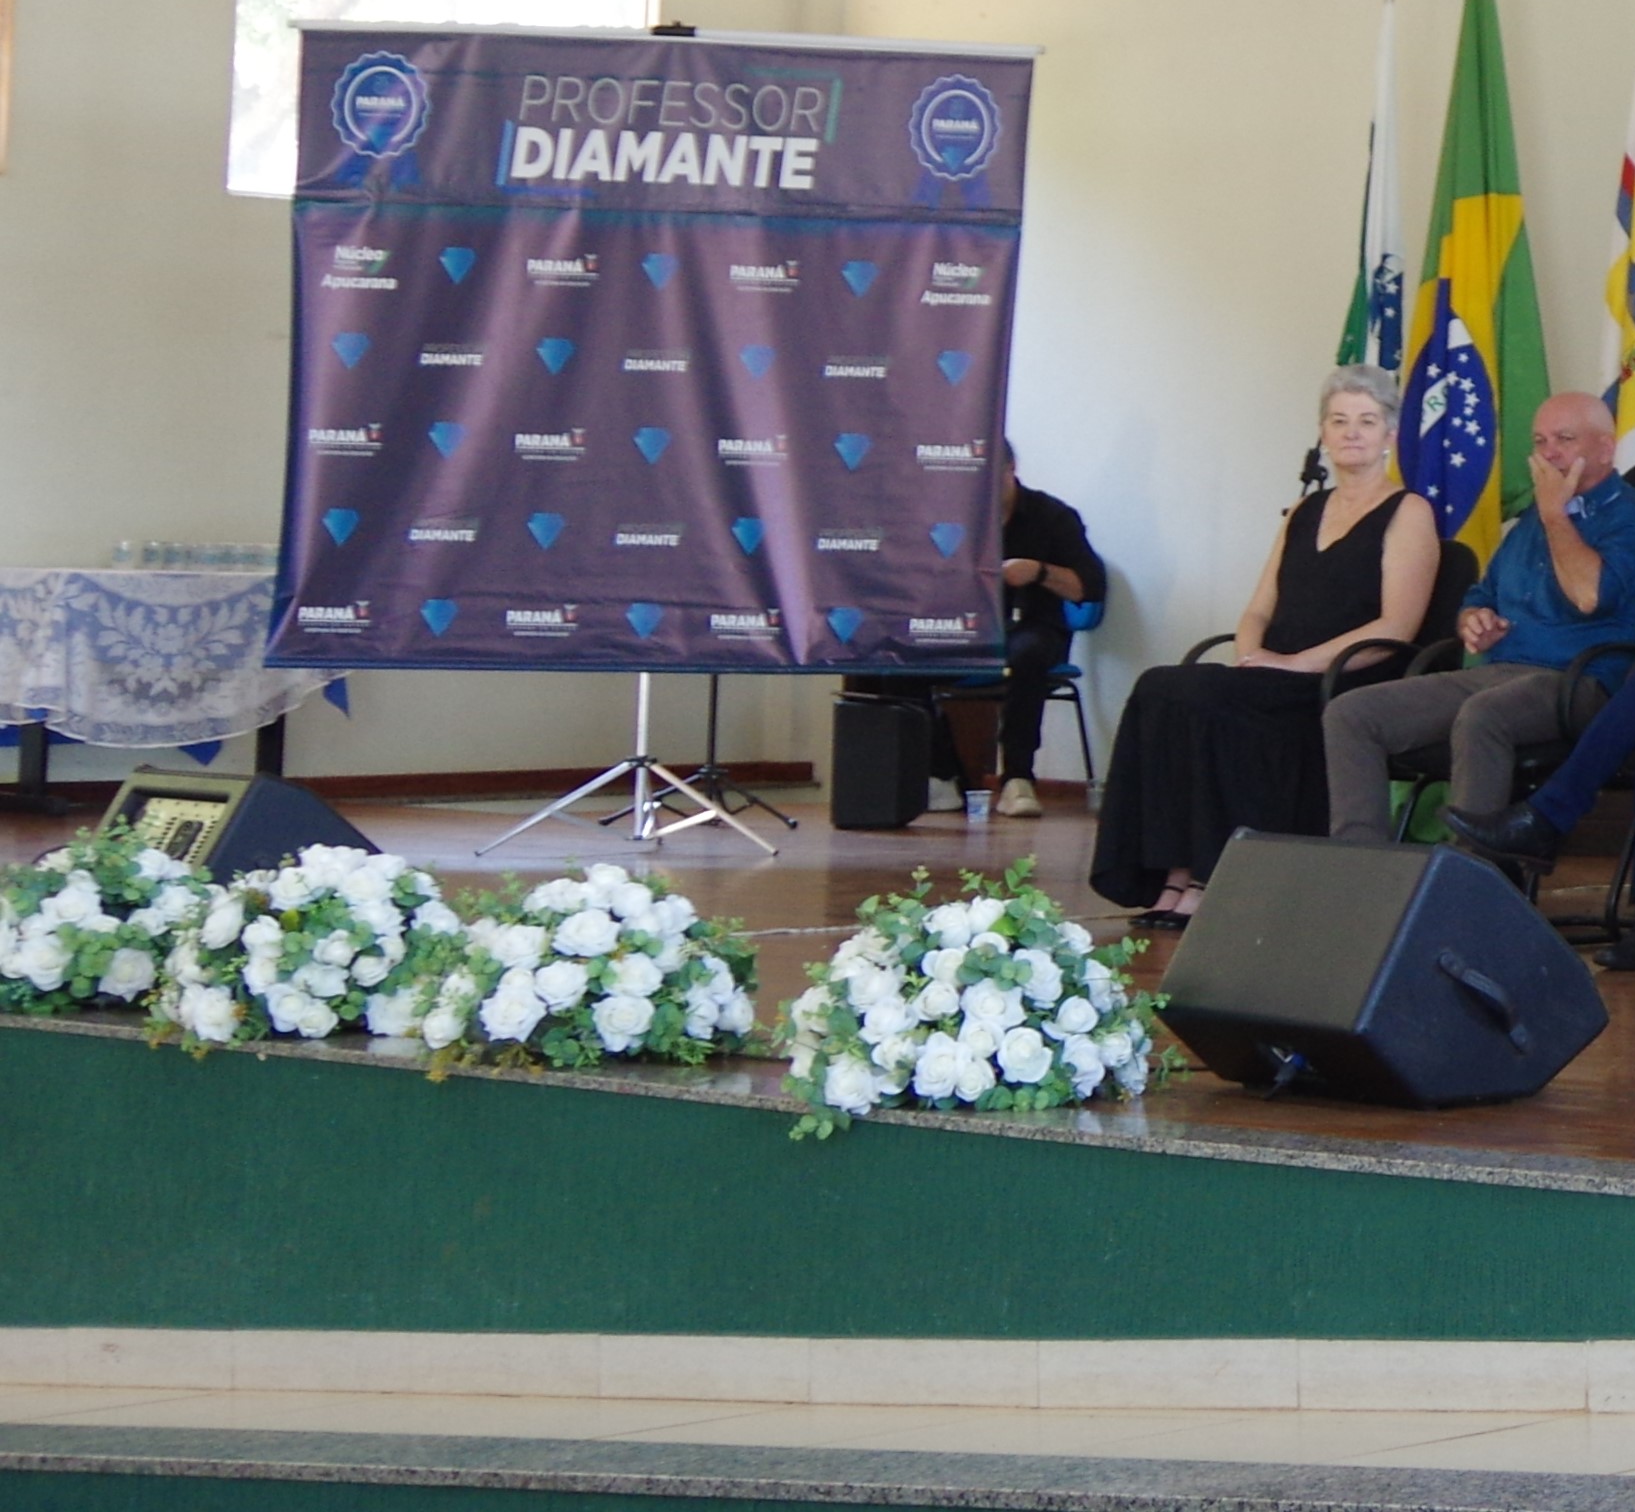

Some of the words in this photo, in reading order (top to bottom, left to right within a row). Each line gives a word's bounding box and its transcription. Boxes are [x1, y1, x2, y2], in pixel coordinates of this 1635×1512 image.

[520, 75, 826, 133] PROFESSOR
[510, 126, 820, 190] DIAMANTE
[729, 264, 784, 279] PARANÁ
[320, 273, 398, 290] Apucarana
[921, 289, 992, 306] Apucarana
[420, 353, 484, 366] DIAMANTE
[623, 358, 688, 372] DIAMANTE
[824, 364, 887, 378] DIAMANTE
[308, 428, 368, 443] PARANÁ
[515, 433, 571, 447] PARANÁ
[718, 438, 774, 453] PARANÁ
[916, 443, 972, 458] PARANÁ
[409, 528, 476, 542] DIAMANTE
[616, 532, 680, 546] DIAMANTE
[817, 537, 879, 551] DIAMANTE
[298, 605, 355, 620] PARANÁ
[506, 609, 563, 624] PARANÁ
[710, 614, 767, 629] PARANÁ
[909, 618, 965, 631] PARANÁ
